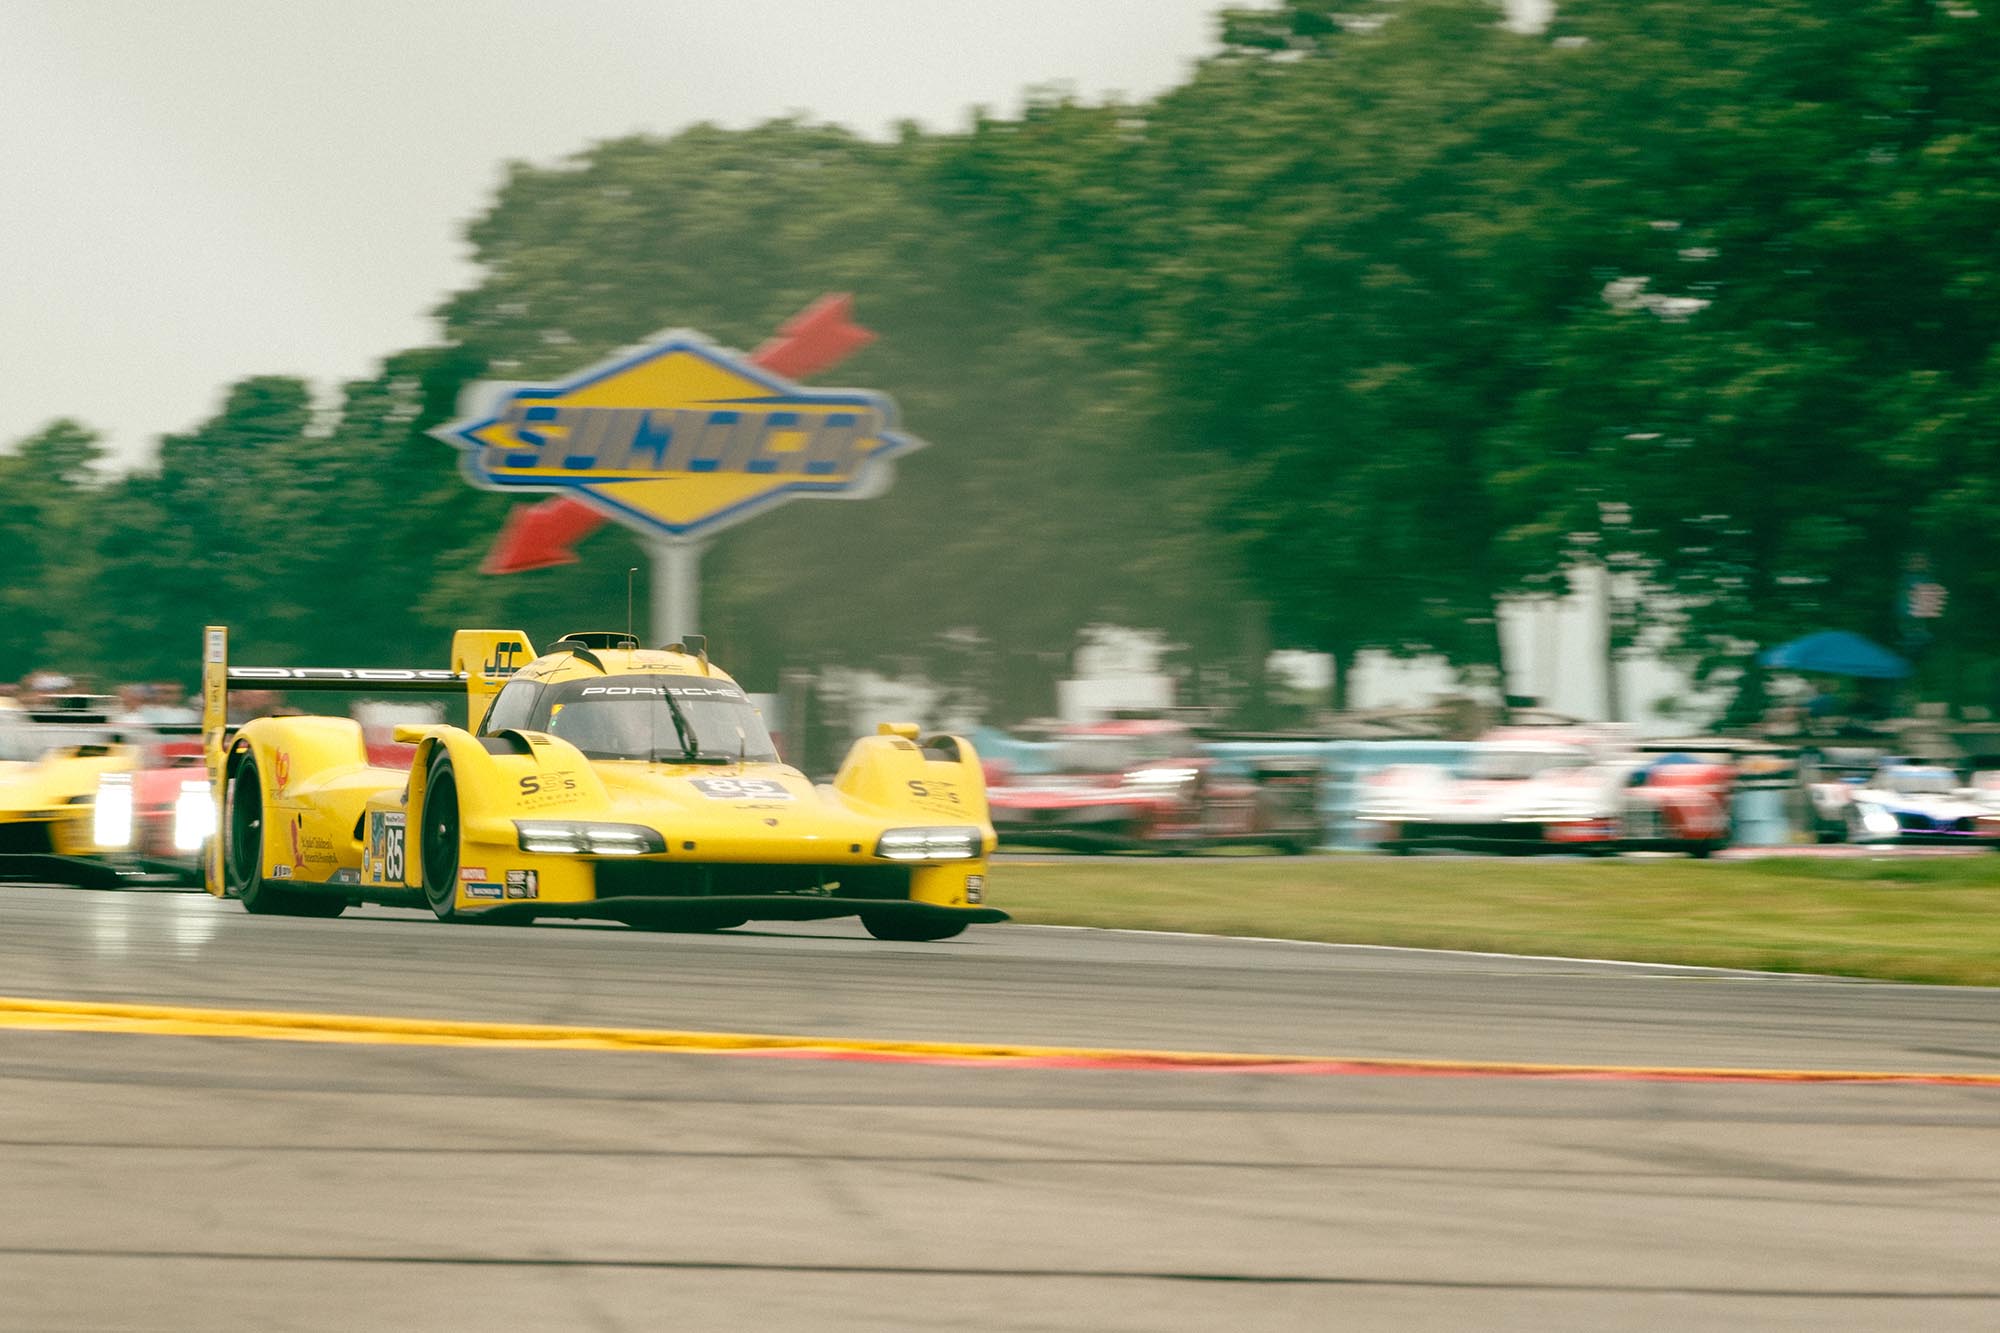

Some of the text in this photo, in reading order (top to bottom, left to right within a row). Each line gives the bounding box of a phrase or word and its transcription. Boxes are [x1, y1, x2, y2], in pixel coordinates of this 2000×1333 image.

[487, 405, 874, 474] SUNOCO
[581, 687, 742, 698] PORSCHE
[703, 780, 776, 793] 85
[386, 828, 403, 880] 85
